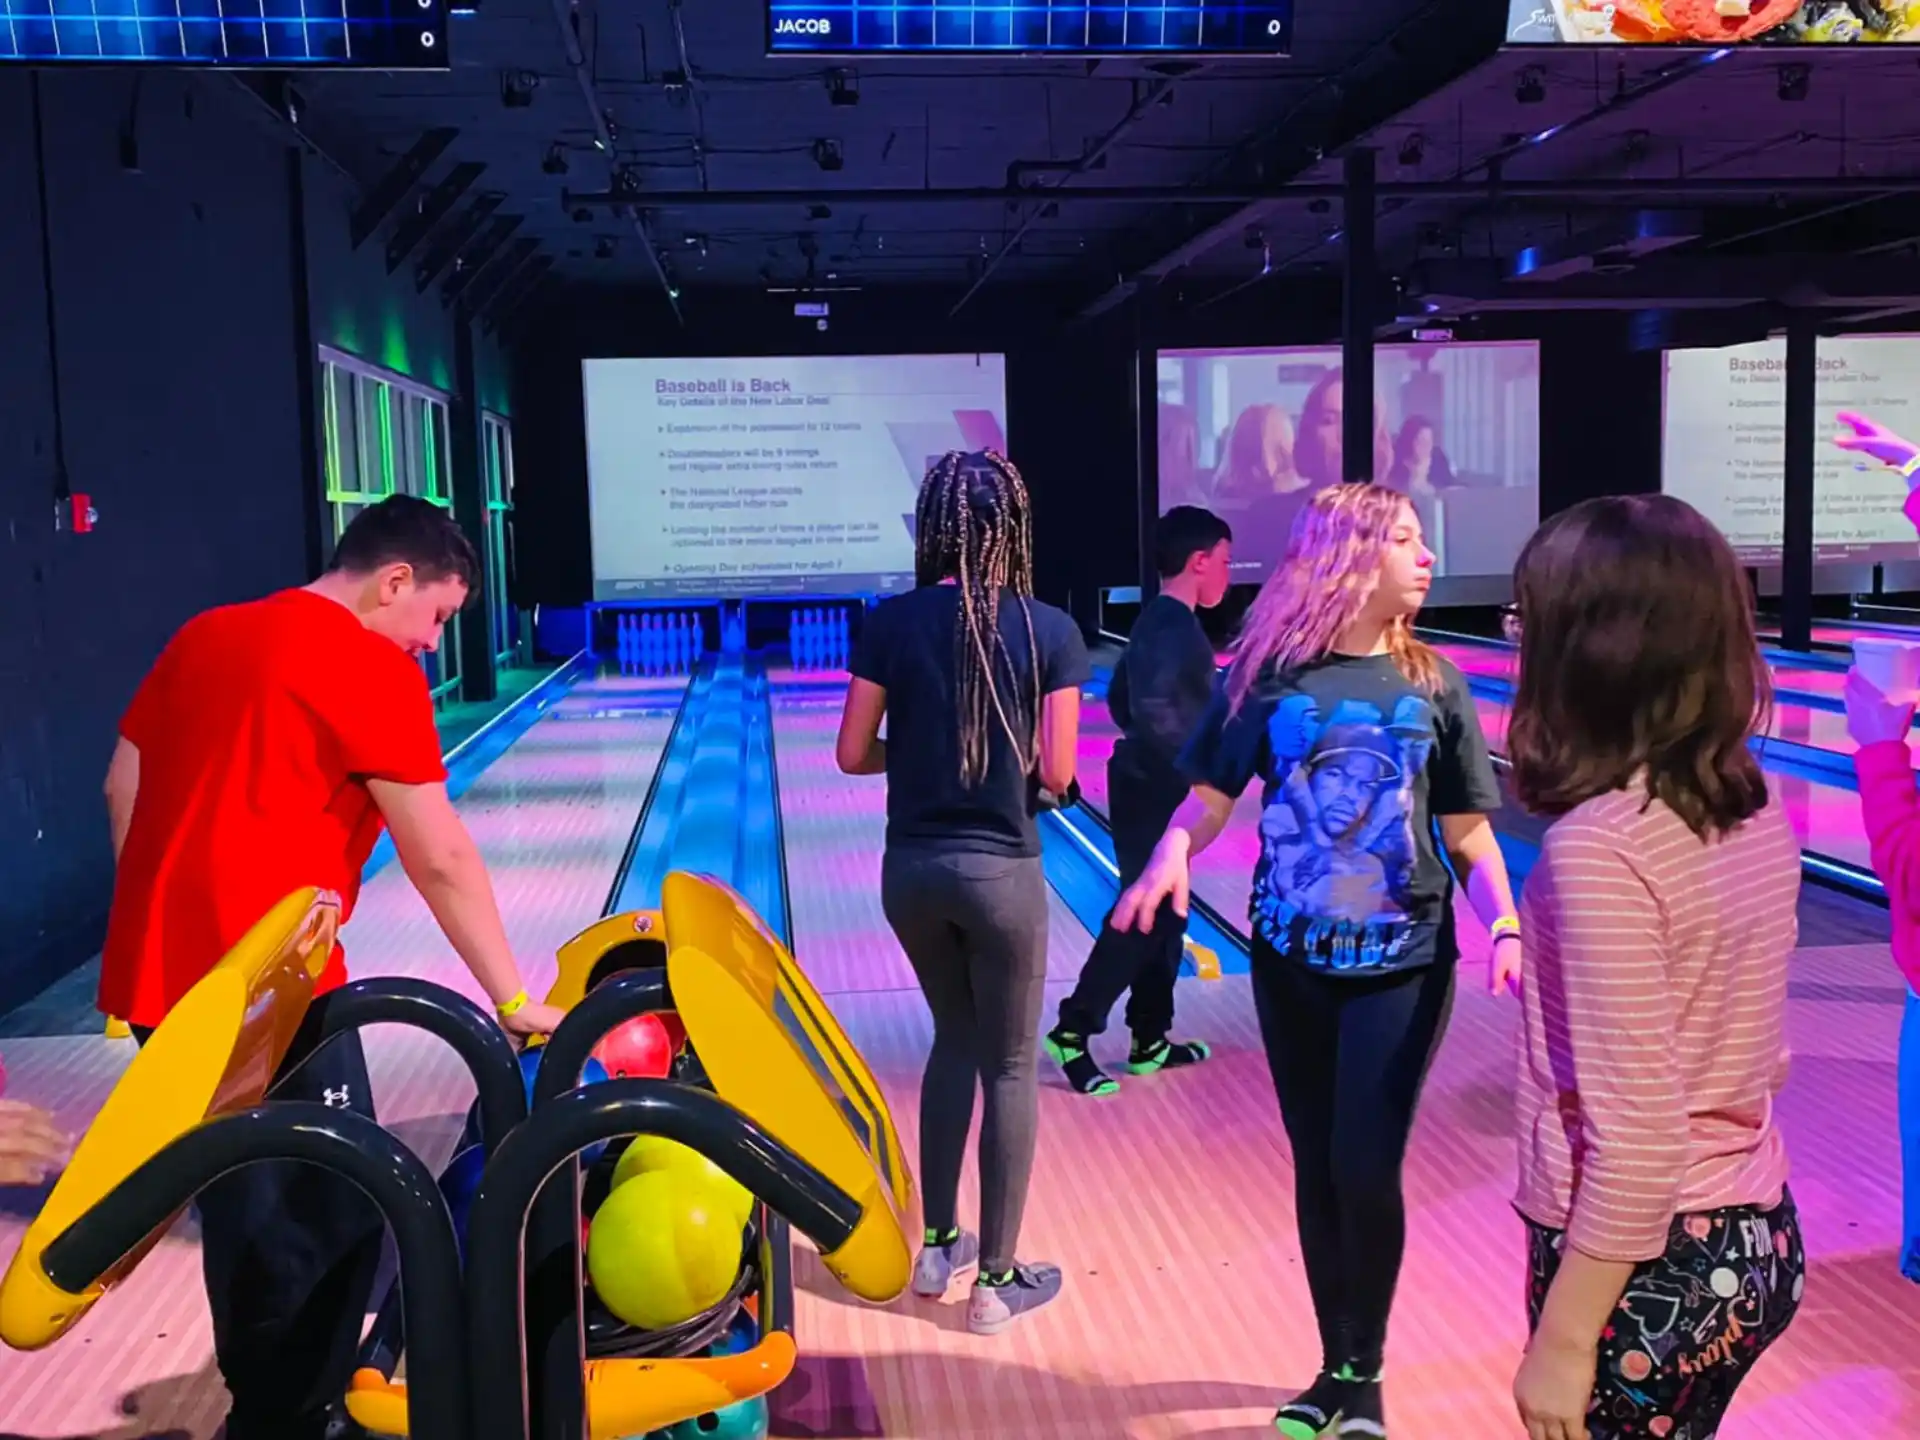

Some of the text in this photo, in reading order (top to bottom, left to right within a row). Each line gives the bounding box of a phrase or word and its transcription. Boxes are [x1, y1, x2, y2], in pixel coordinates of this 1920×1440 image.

[774, 18, 831, 34] JACOB
[1267, 19, 1281, 35] 0
[420, 31, 435, 48] 0
[1729, 358, 1786, 371] Baseba
[655, 378, 791, 394] Baseball is Back
[1677, 1311, 1744, 1379] play
